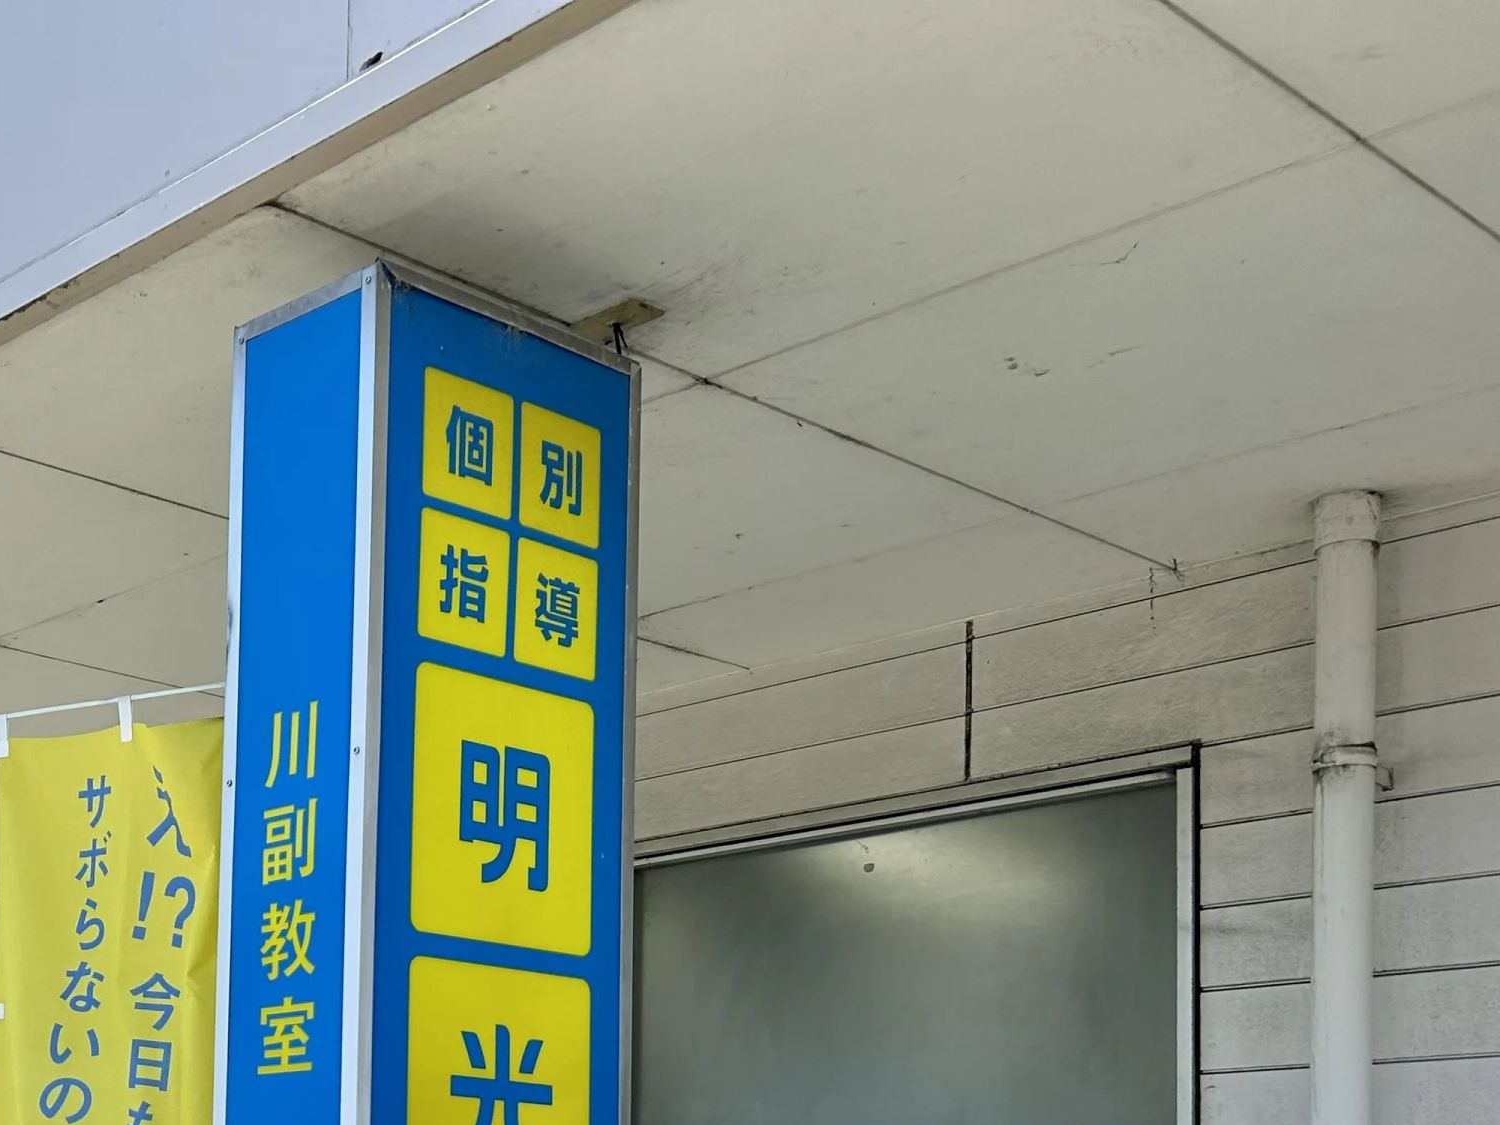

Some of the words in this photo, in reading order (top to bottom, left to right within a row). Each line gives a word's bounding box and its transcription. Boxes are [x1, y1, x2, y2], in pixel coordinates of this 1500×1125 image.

[444, 404, 584, 517] 個別
[438, 544, 581, 650] 指導
[257, 699, 319, 1076] 川副教室
